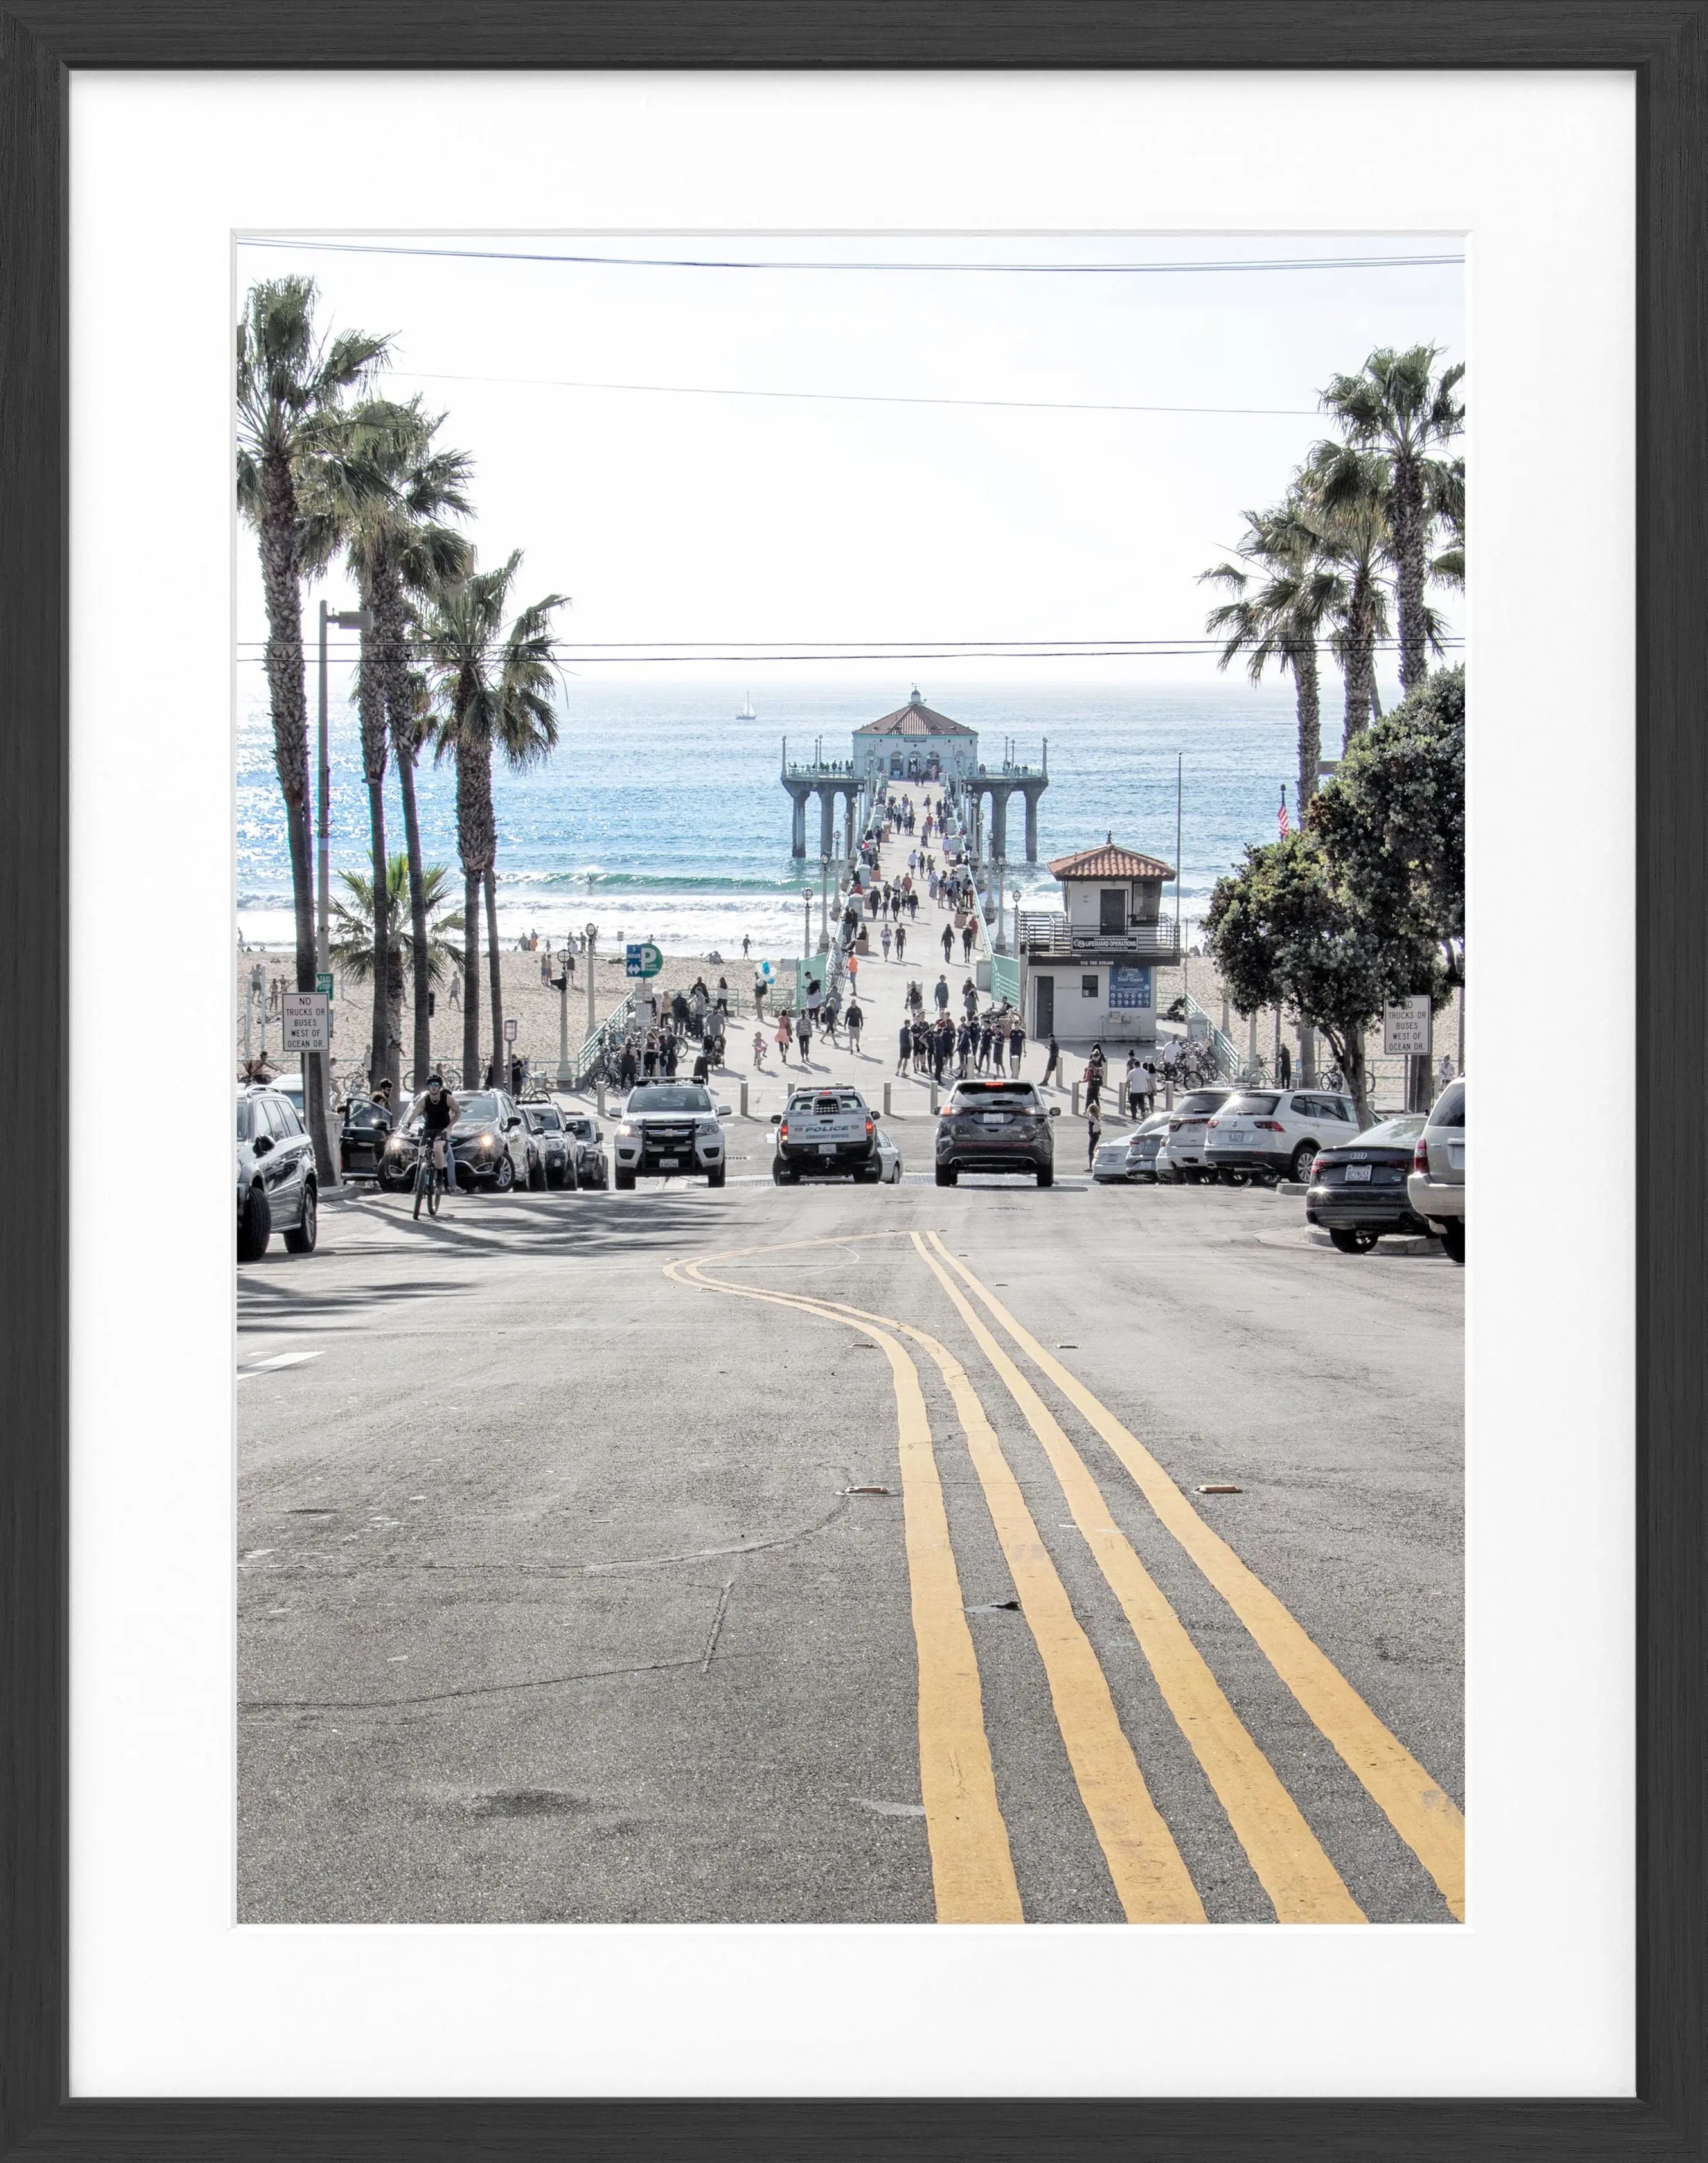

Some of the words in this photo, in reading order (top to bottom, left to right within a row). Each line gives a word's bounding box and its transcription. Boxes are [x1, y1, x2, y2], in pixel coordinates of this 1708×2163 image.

[641, 947, 657, 972] P
[299, 997, 312, 1006] NO
[1417, 1011, 1427, 1019] OR
[294, 1019, 317, 1027] BUSES
